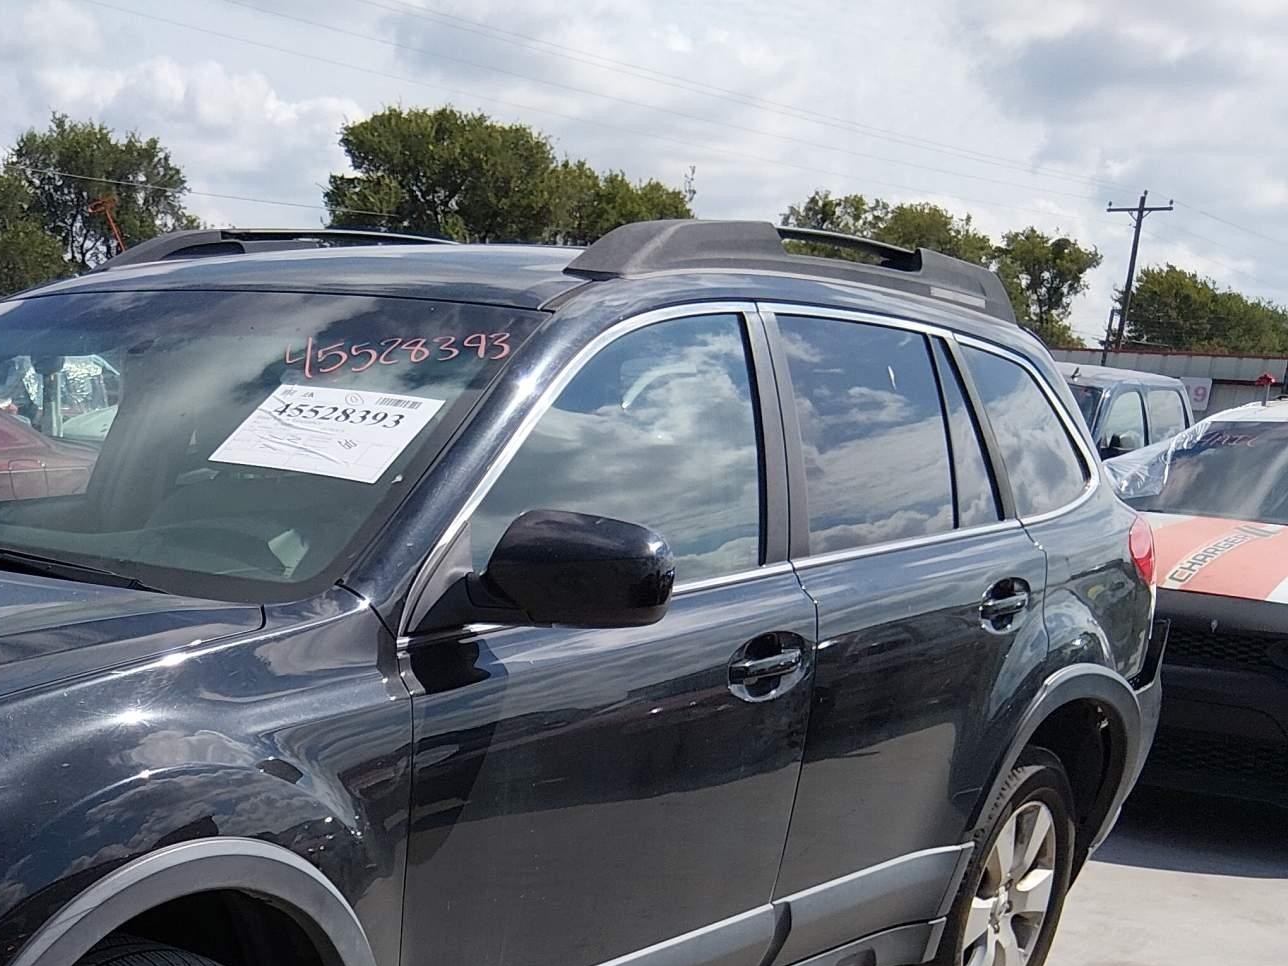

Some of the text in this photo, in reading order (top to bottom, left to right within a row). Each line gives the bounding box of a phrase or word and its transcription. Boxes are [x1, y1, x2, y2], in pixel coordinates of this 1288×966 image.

[285, 331, 511, 379] 45528393
[274, 402, 405, 429] 45528393
[1168, 533, 1251, 583] CHARGER
